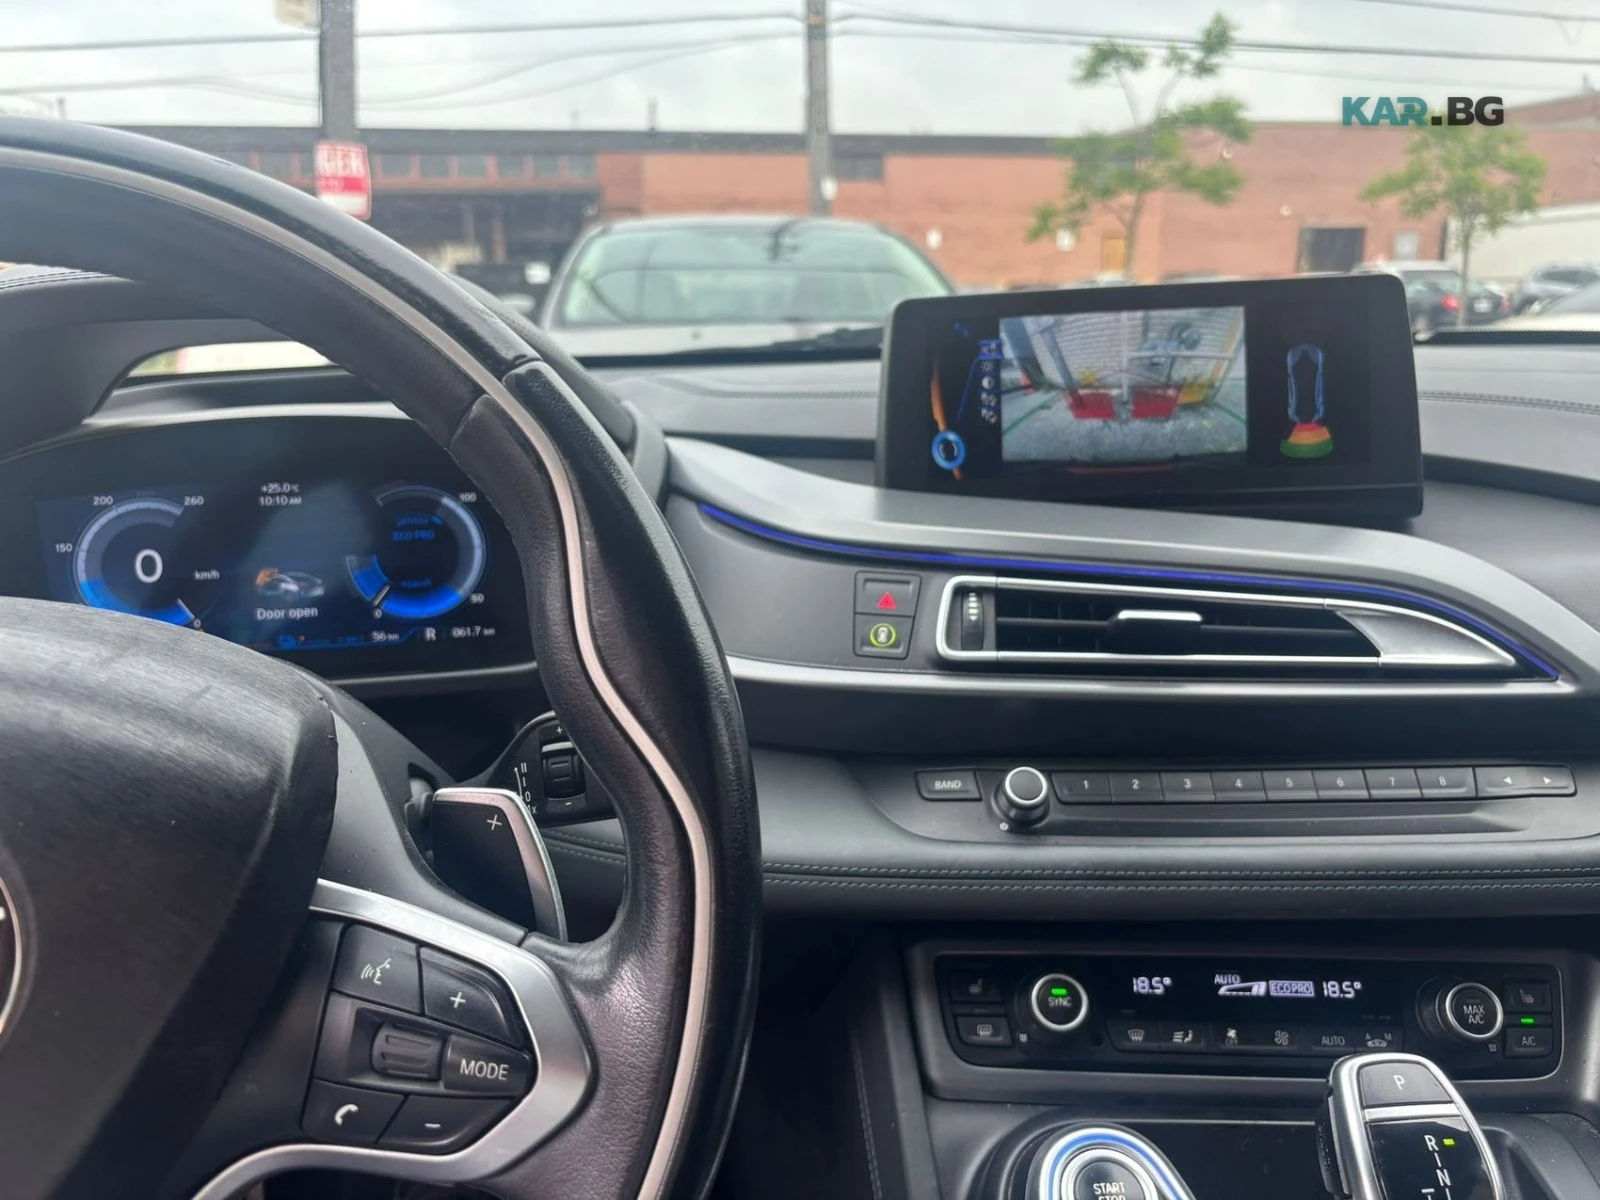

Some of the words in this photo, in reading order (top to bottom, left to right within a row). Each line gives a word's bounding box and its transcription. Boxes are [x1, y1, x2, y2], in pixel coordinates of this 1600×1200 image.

[93, 495, 114, 506] 200
[184, 495, 204, 506] 260
[259, 495, 288, 507] 10:10
[459, 492, 477, 502] 100
[55, 542, 73, 553] 150
[135, 549, 163, 584] 0
[194, 569, 220, 581] km/h
[256, 606, 286, 621] Door
[288, 606, 319, 621] open
[425, 626, 437, 642] R
[934, 779, 961, 790] BAND
[1081, 779, 1089, 790] 1
[1131, 778, 1140, 790] 2
[1182, 778, 1192, 789] 3
[1233, 778, 1243, 789] 4
[1284, 776, 1294, 788] 5
[1335, 776, 1345, 788] 6
[1387, 776, 1396, 787] 7
[1437, 775, 1448, 787] 8
[1213, 973, 1241, 985] AUTO
[1048, 997, 1072, 1007] SYNC
[1463, 1004, 1485, 1015] MAX
[1468, 1014, 1485, 1025] A/C
[1321, 1035, 1346, 1046] AUTO
[1521, 1035, 1536, 1046] A/C
[459, 1058, 509, 1081] MODE
[1393, 1074, 1406, 1090] P
[1424, 1134, 1439, 1151] R
[1436, 1168, 1451, 1187] N
[1093, 1182, 1125, 1195] START
